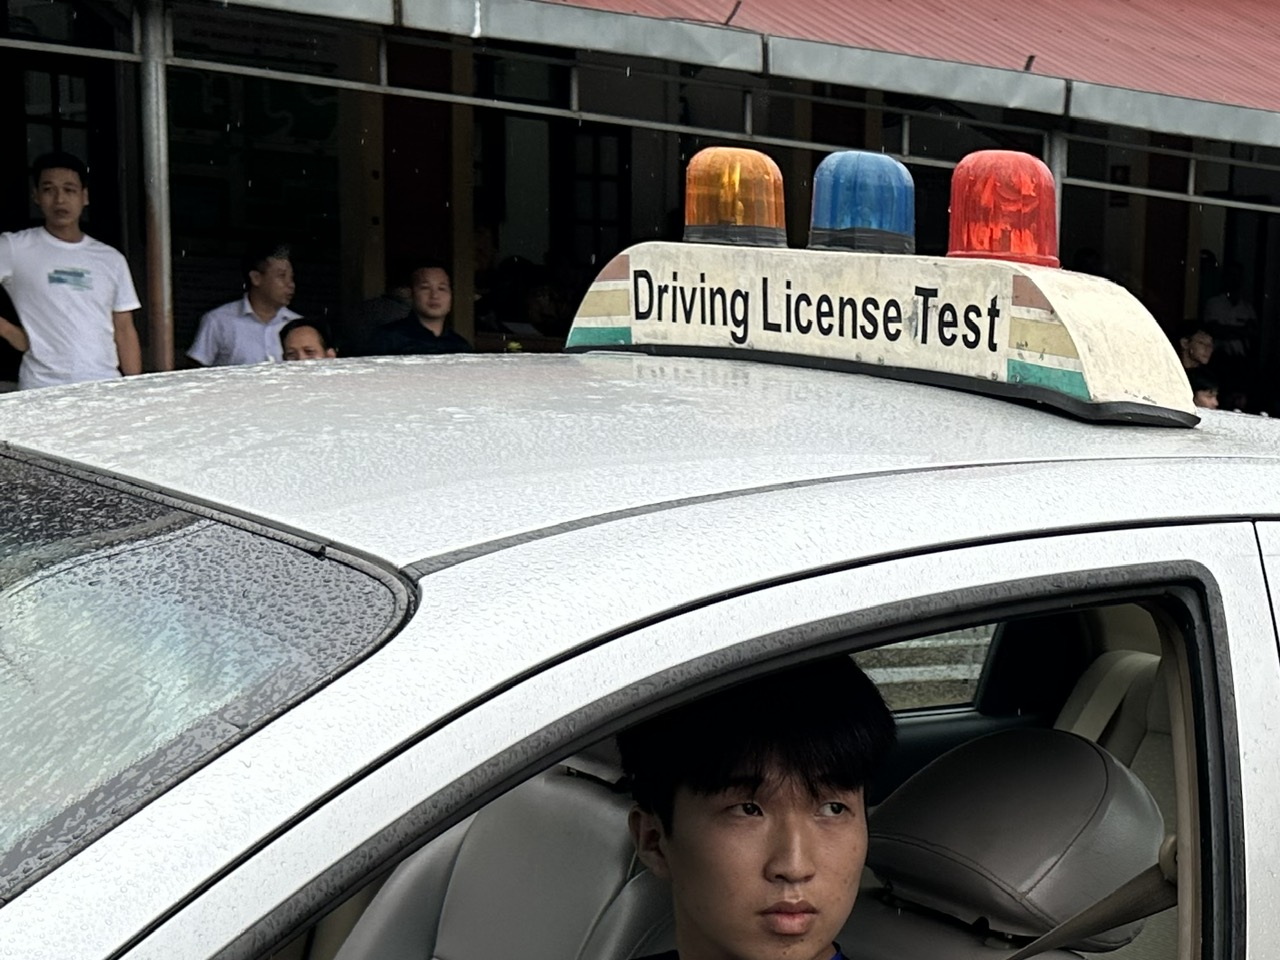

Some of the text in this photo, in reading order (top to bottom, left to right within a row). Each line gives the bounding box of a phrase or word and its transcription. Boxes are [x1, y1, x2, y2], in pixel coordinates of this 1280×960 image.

[633, 269, 1000, 353] Driving License Test
